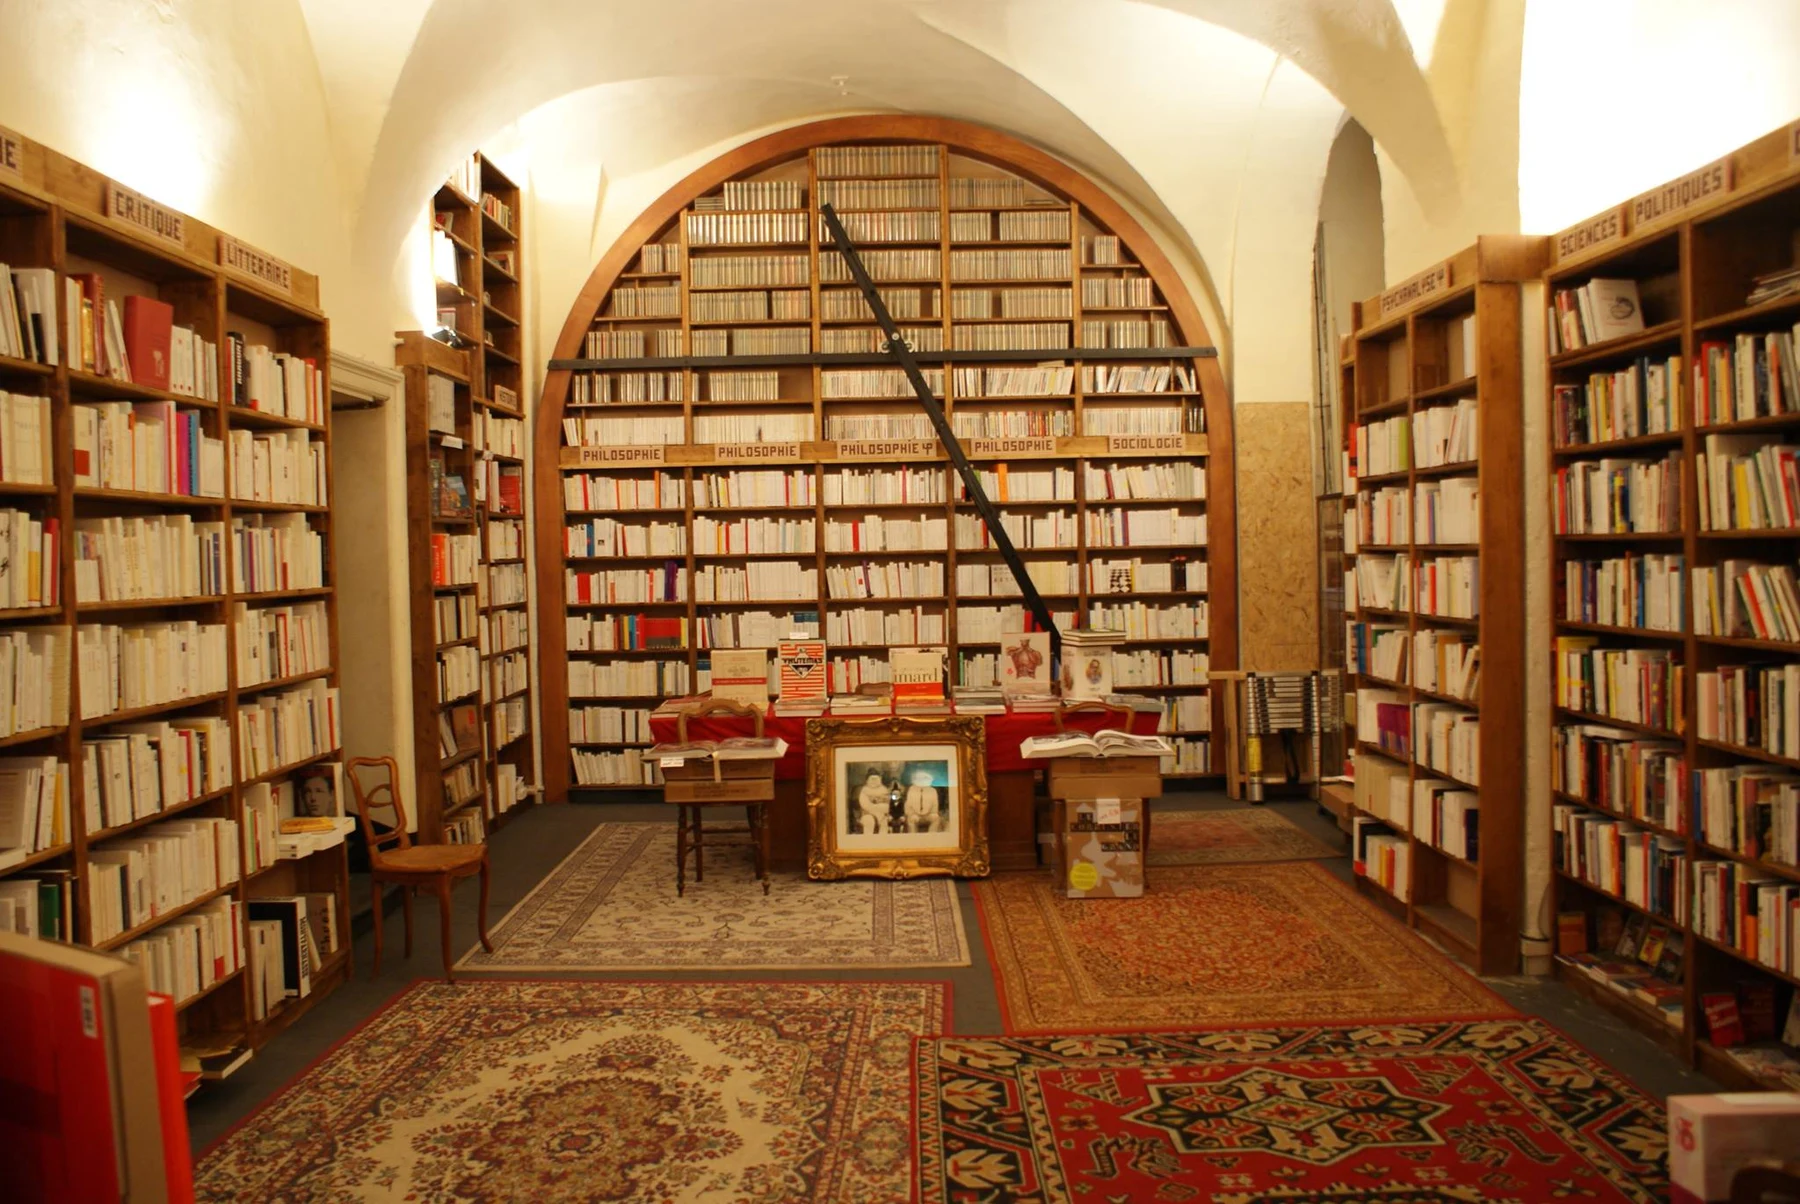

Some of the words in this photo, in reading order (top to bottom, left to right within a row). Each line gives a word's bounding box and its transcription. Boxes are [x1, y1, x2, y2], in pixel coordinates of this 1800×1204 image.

[1635, 166, 1722, 225] POLITIQUES
[115, 190, 182, 241] CRITIQUE
[1560, 213, 1618, 257] SCIENCES
[227, 241, 289, 289] LITTERAIRE
[718, 443, 797, 457] PHILOSOPHIE
[841, 441, 919, 456] PHILOSOPHIE
[974, 438, 1053, 452] PHILOSOPHIE
[1113, 436, 1182, 450] SOCIOLOGIE
[583, 447, 661, 461] PHILOSOPHIE
